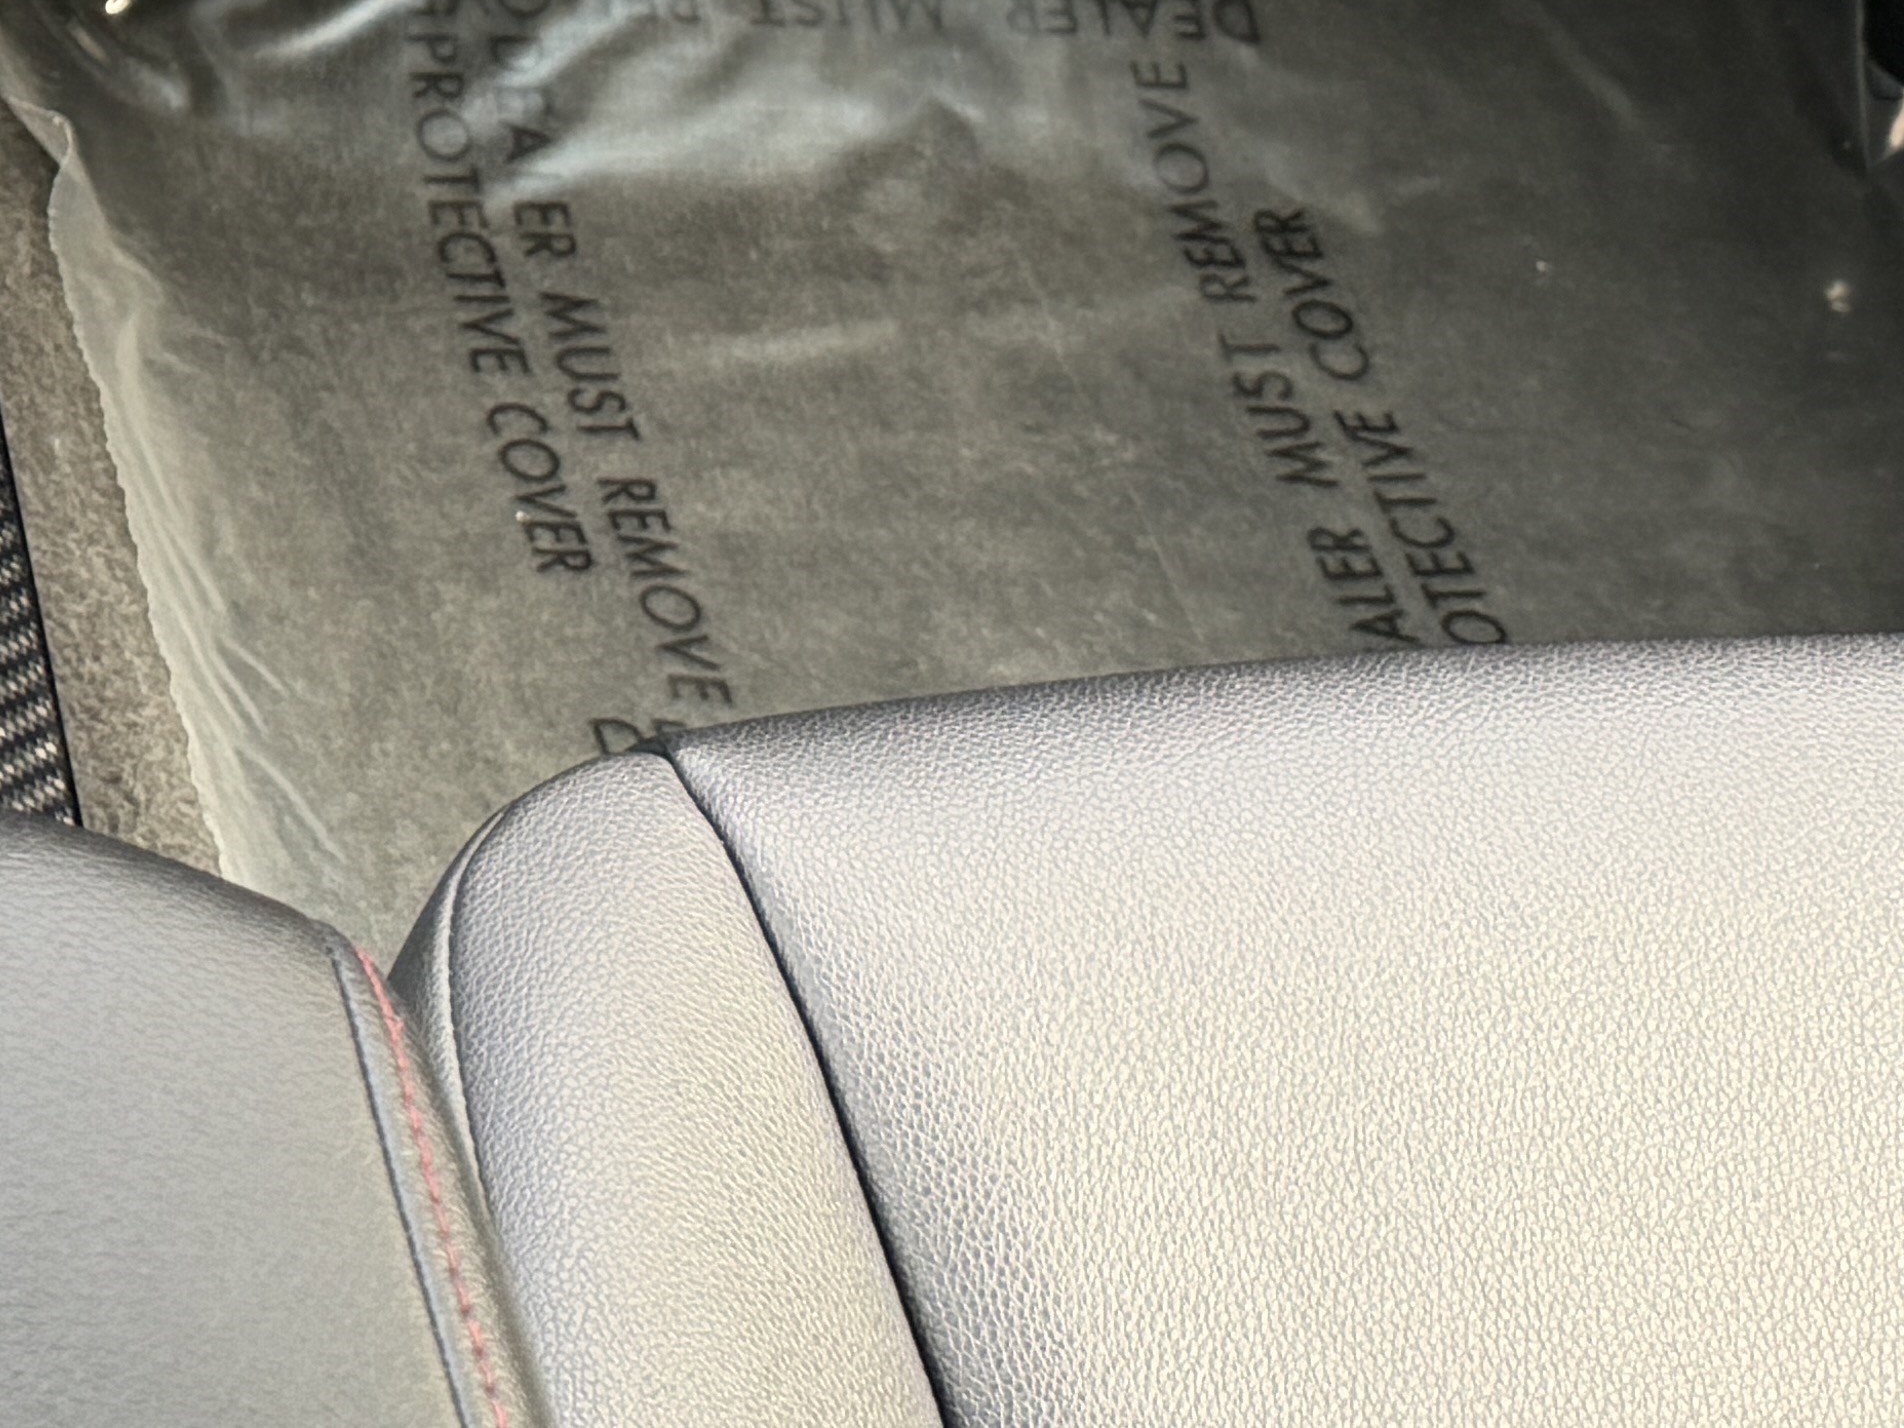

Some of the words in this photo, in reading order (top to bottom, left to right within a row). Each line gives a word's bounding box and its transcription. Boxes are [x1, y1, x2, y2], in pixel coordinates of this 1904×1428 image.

[403, 31, 533, 375] PROTECTIVE
[485, 402, 595, 574] COVER
[1130, 59, 1257, 306] REMOVE
[1253, 206, 1372, 383] COVER
[539, 291, 642, 442] MUST
[595, 477, 735, 709] REMOVE
[1217, 332, 1340, 489] MUST
